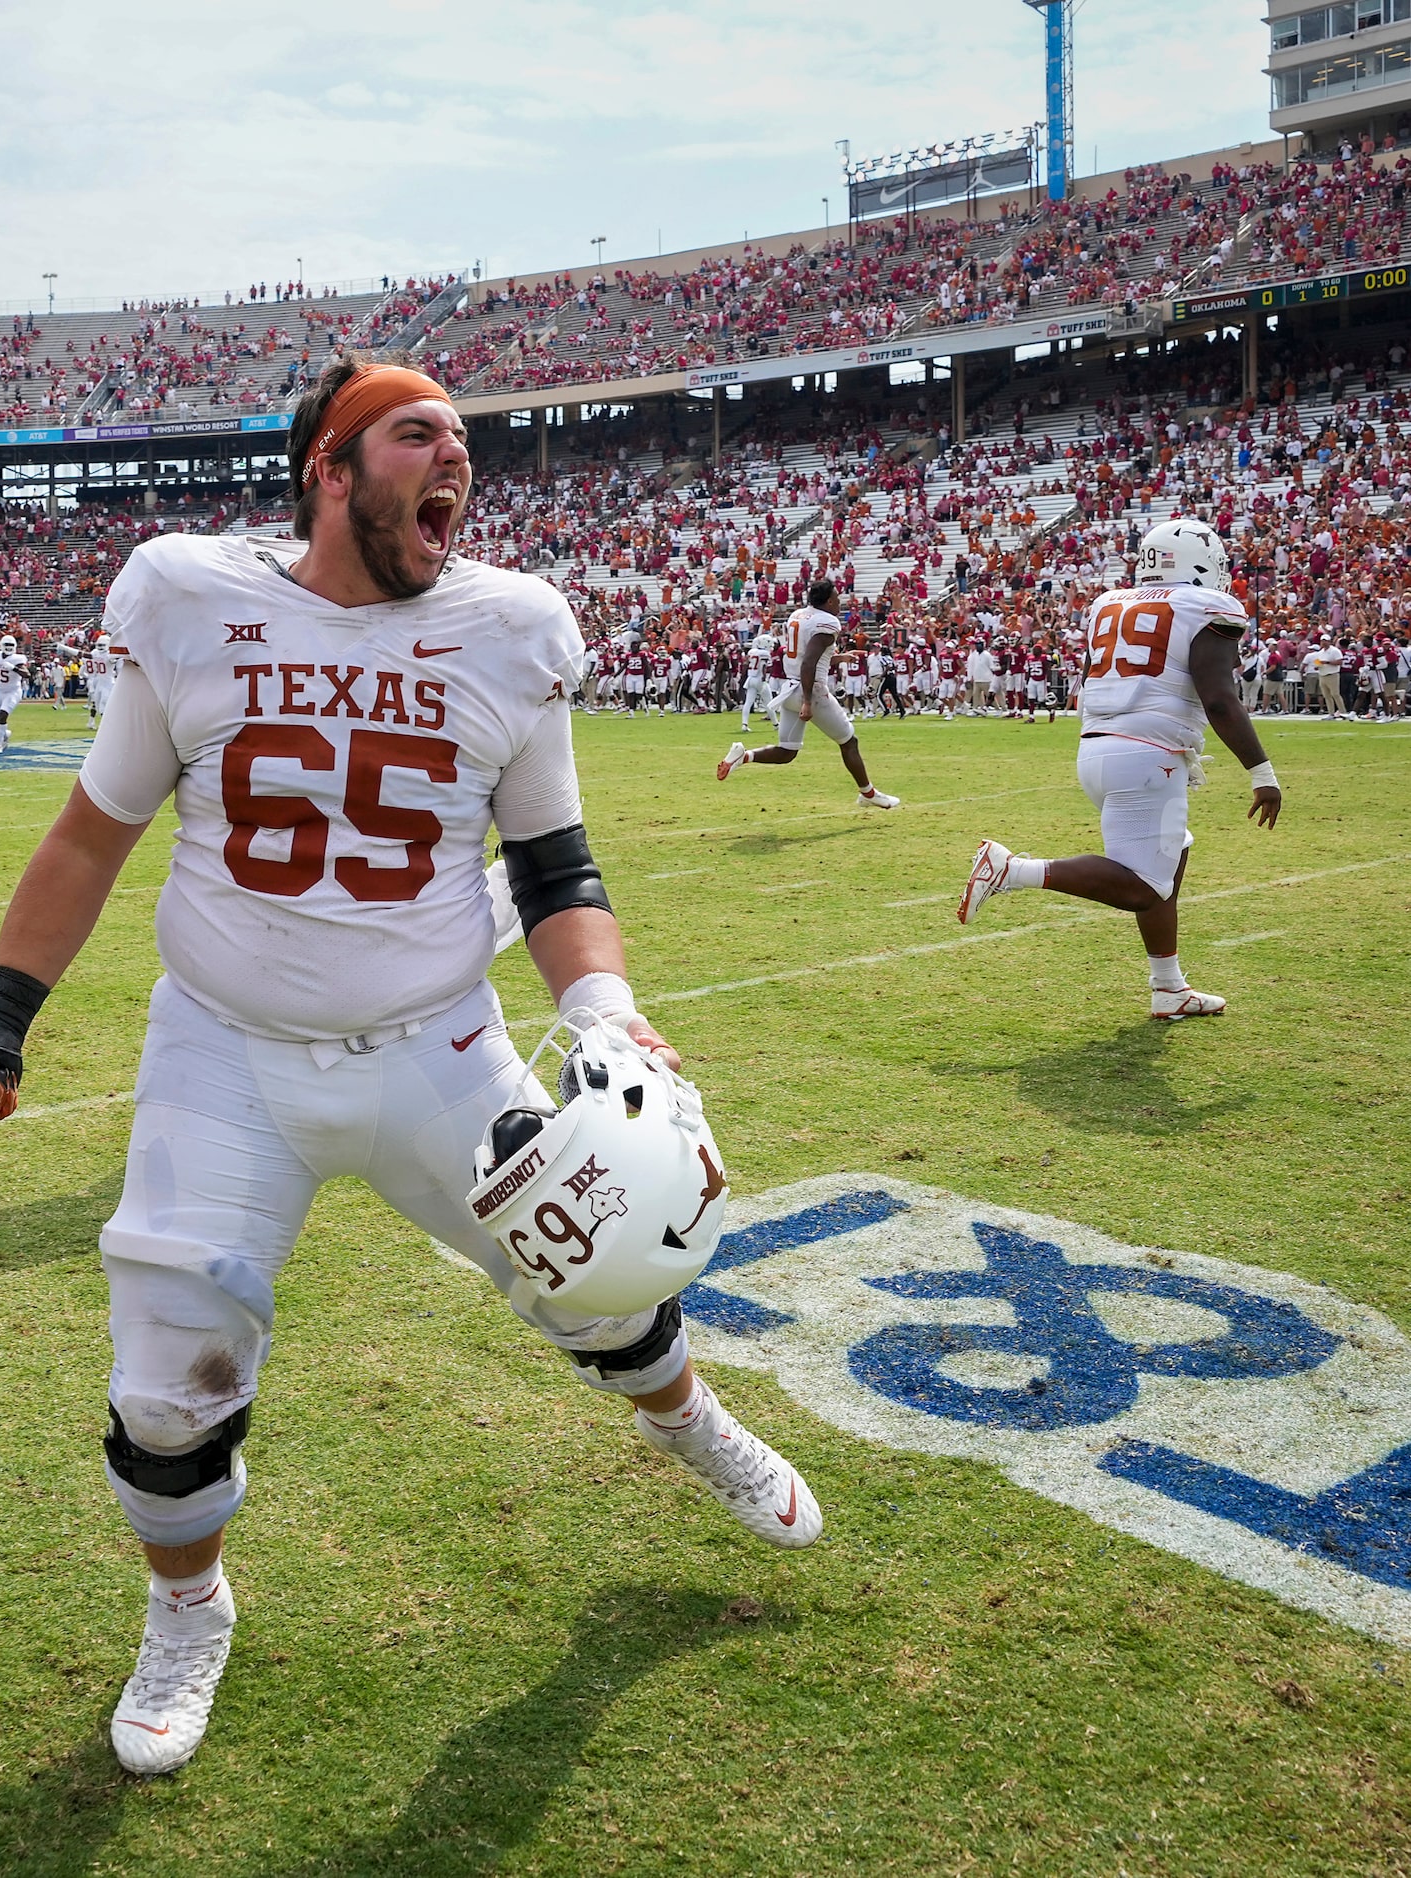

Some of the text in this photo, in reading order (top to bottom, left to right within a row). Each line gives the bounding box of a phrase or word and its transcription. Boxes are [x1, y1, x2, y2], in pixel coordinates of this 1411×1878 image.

[1291, 281, 1314, 292] DOWN
[1330, 277, 1341, 285] GO
[1364, 268, 1407, 290] 0:00
[1261, 290, 1273, 306] 0
[1299, 291, 1307, 302] 1
[1322, 285, 1338, 299] 10
[1191, 298, 1247, 314] OKLAHOMA
[1060, 322, 1084, 334] TUFF
[869, 347, 913, 361] TUFF SHED
[700, 371, 739, 384] TUFF SHED
[152, 420, 239, 434] WINSTAR WORLD RESORT
[248, 418, 267, 428] AT&T
[28, 432, 48, 441] AT&T
[302, 455, 315, 484] HOOK
[223, 621, 268, 643] XII
[1087, 602, 1175, 678] 99
[233, 663, 446, 731] TEXAS
[221, 723, 460, 902] 65
[560, 1153, 611, 1202] XII
[508, 1201, 594, 1292] 65
